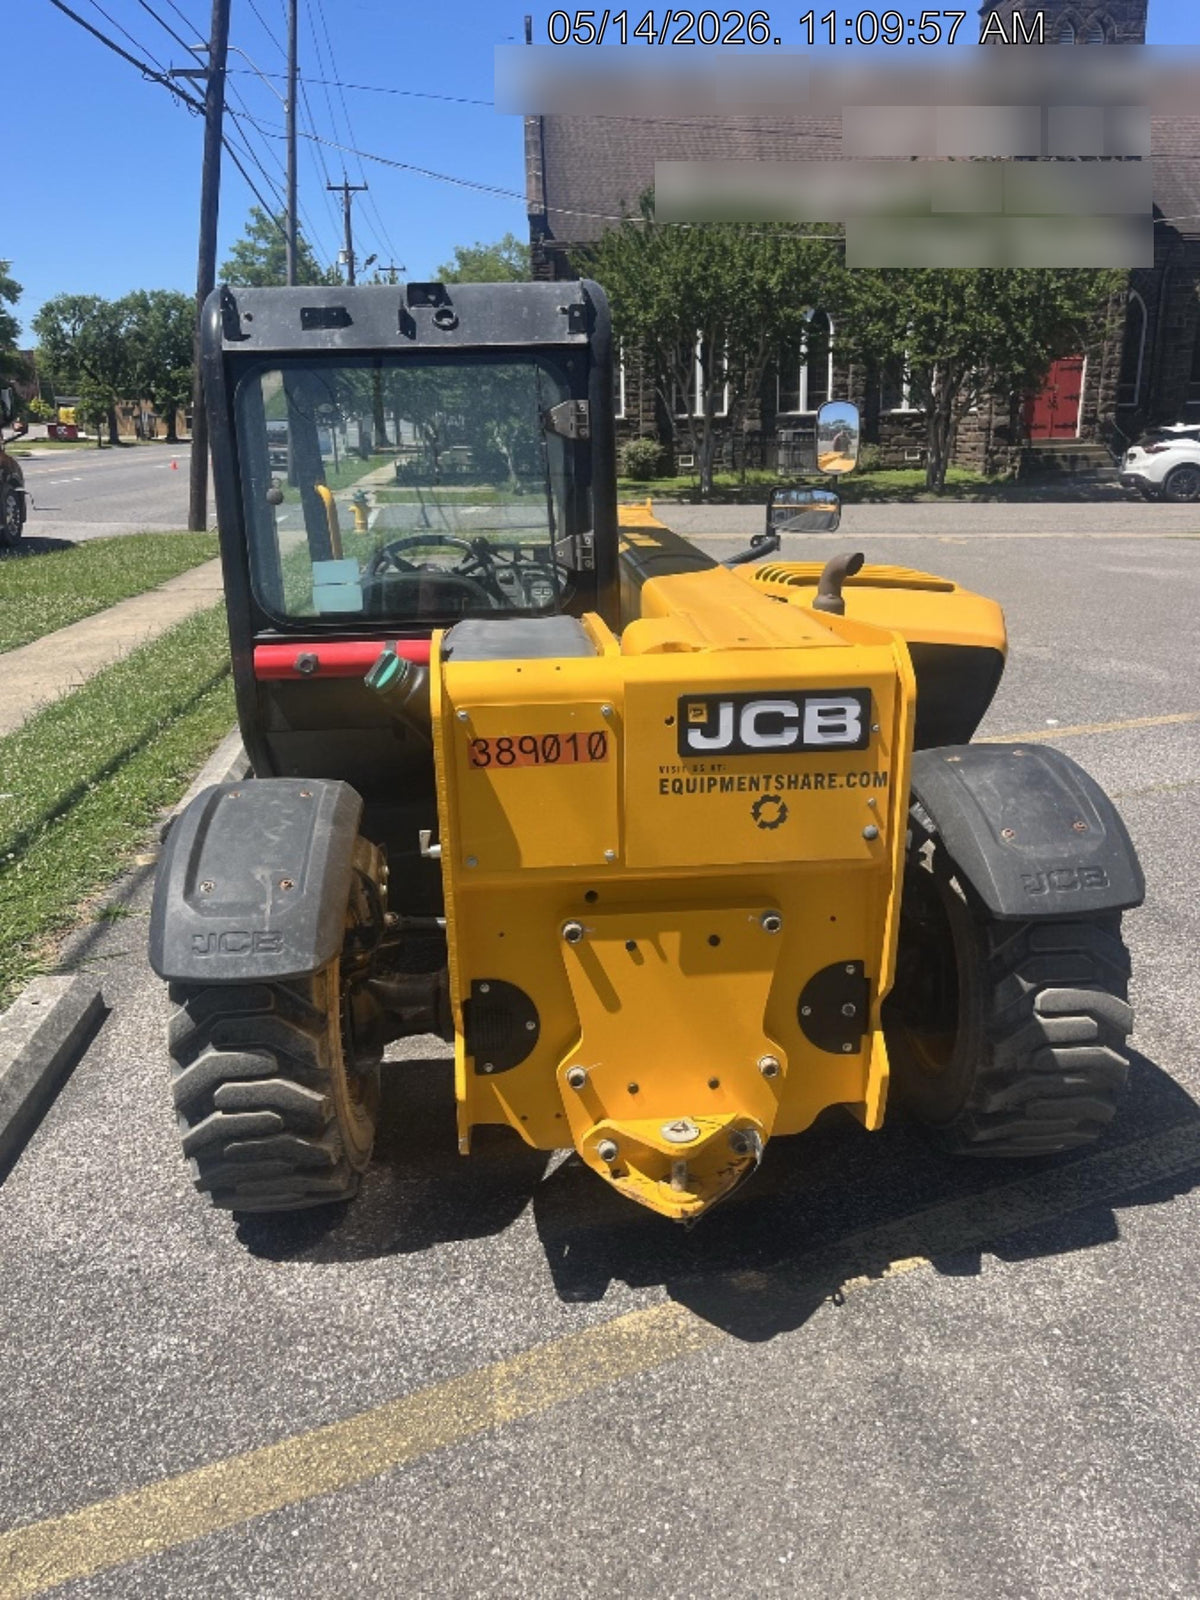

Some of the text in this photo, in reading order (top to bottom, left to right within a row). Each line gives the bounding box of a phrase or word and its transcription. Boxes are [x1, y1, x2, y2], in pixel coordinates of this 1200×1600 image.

[687, 697, 862, 749] JCB
[472, 730, 607, 767] 389010
[659, 765, 686, 774] VISIT
[693, 764, 705, 772] US
[659, 770, 889, 795] EQUIPMENTSHARE.COM
[1020, 866, 1111, 897] JCB
[191, 930, 284, 959] JCB
